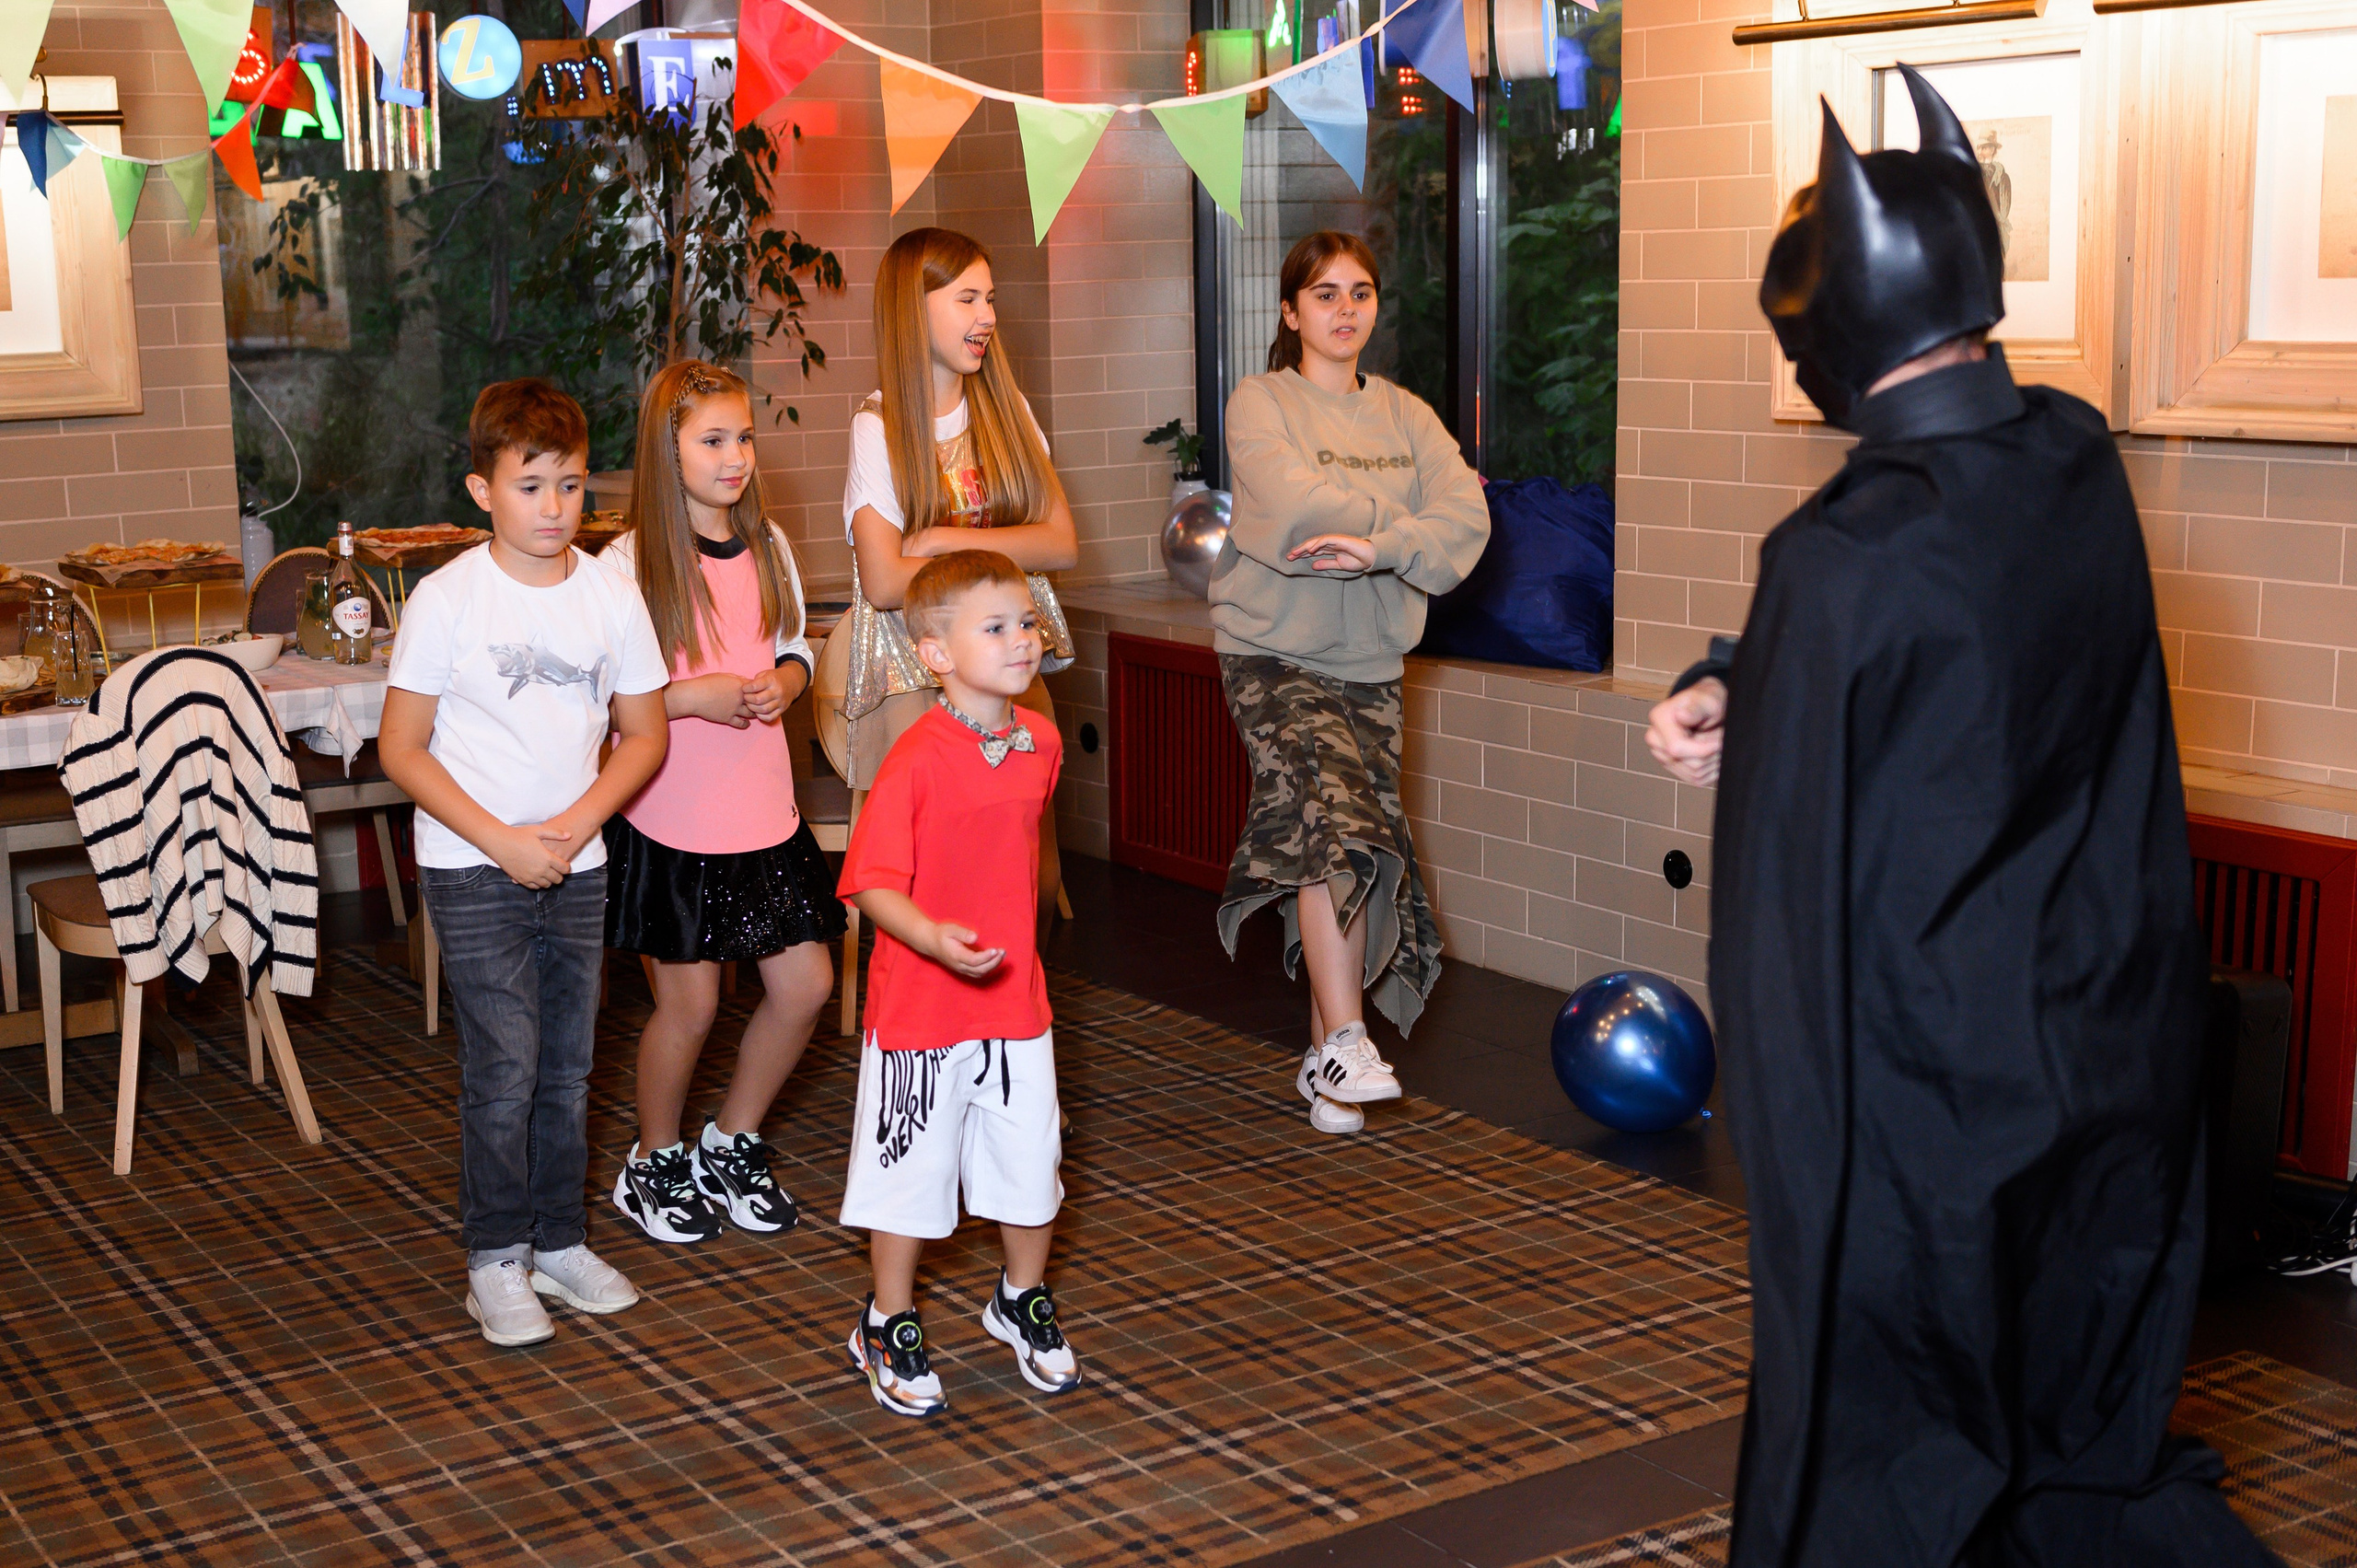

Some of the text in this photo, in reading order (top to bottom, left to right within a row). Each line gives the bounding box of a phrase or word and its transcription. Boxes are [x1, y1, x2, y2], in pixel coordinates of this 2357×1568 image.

[441, 18, 495, 86] Z
[646, 55, 691, 113] E
[343, 611, 369, 620] TASSAY
